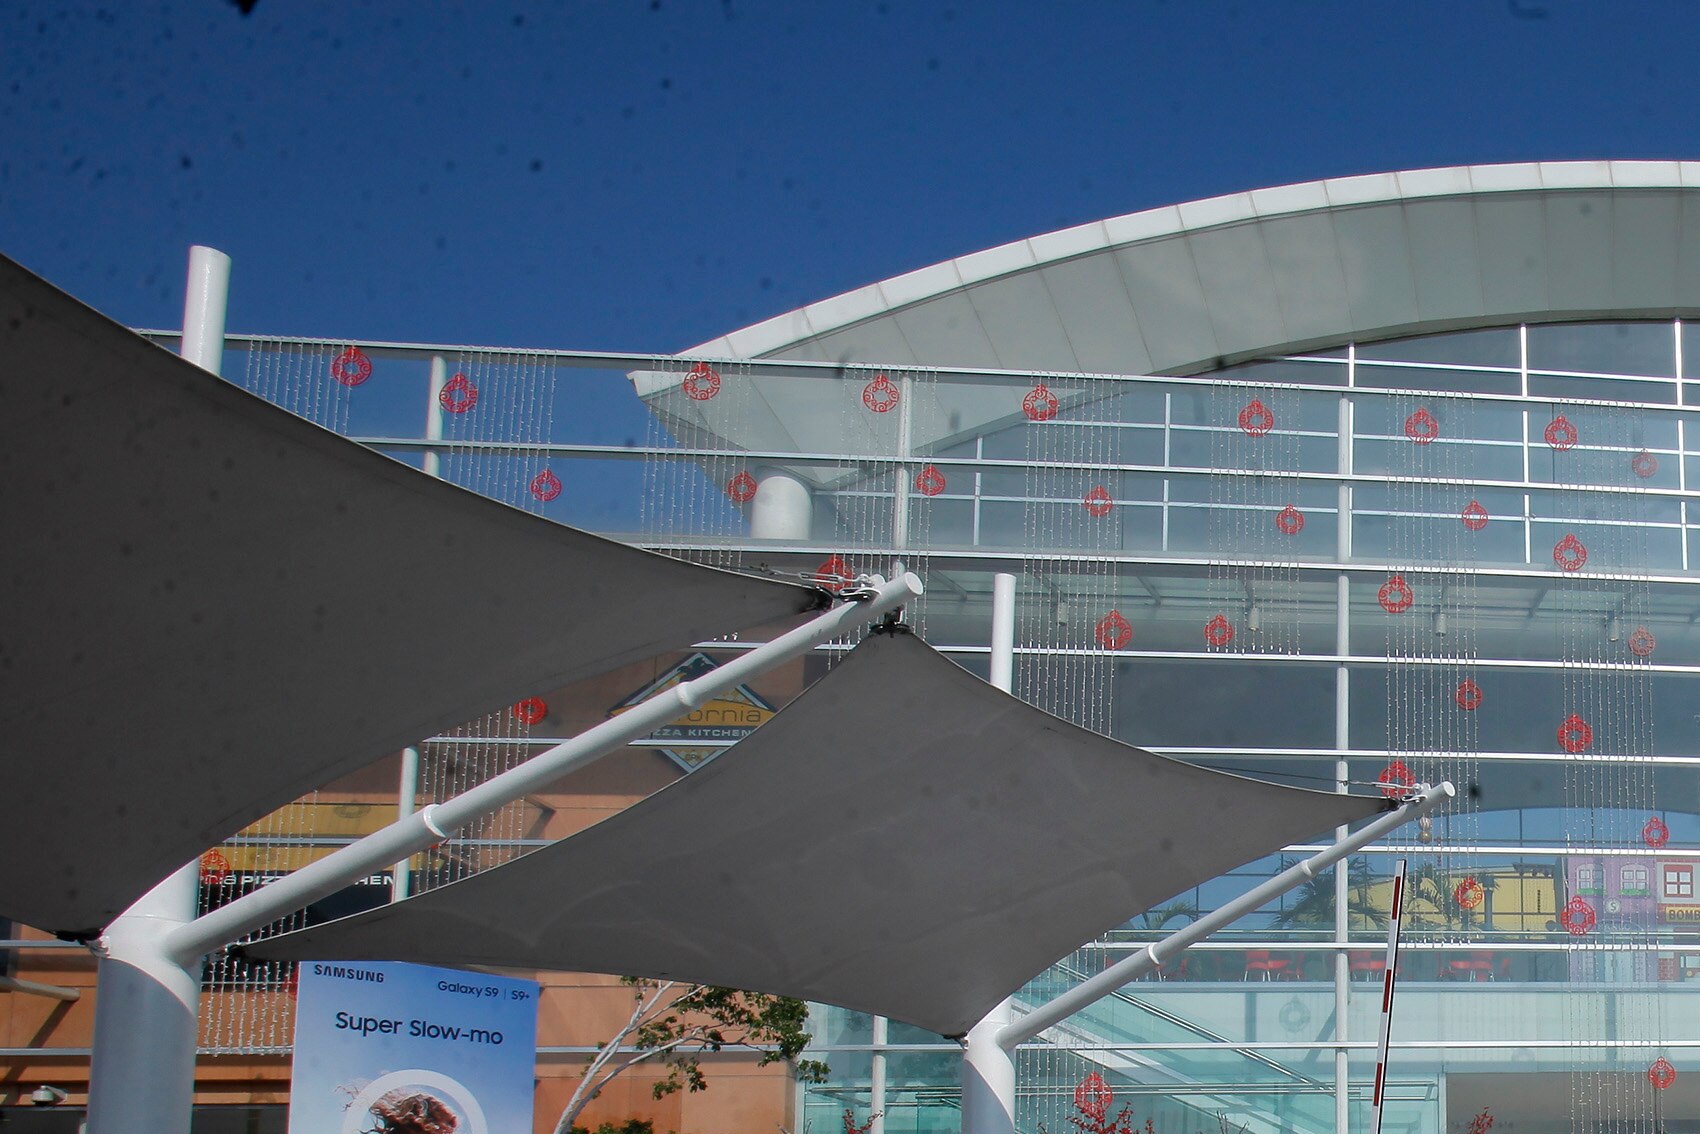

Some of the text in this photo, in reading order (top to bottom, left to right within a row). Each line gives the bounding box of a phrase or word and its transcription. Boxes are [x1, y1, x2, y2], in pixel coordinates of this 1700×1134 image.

[678, 705, 761, 722] ornia
[688, 729, 751, 737] KITCHEN
[314, 964, 385, 983] SAMSUNG
[437, 980, 530, 1001] Galaxy S9 S9+
[335, 1011, 504, 1045] Super Slow-mo
